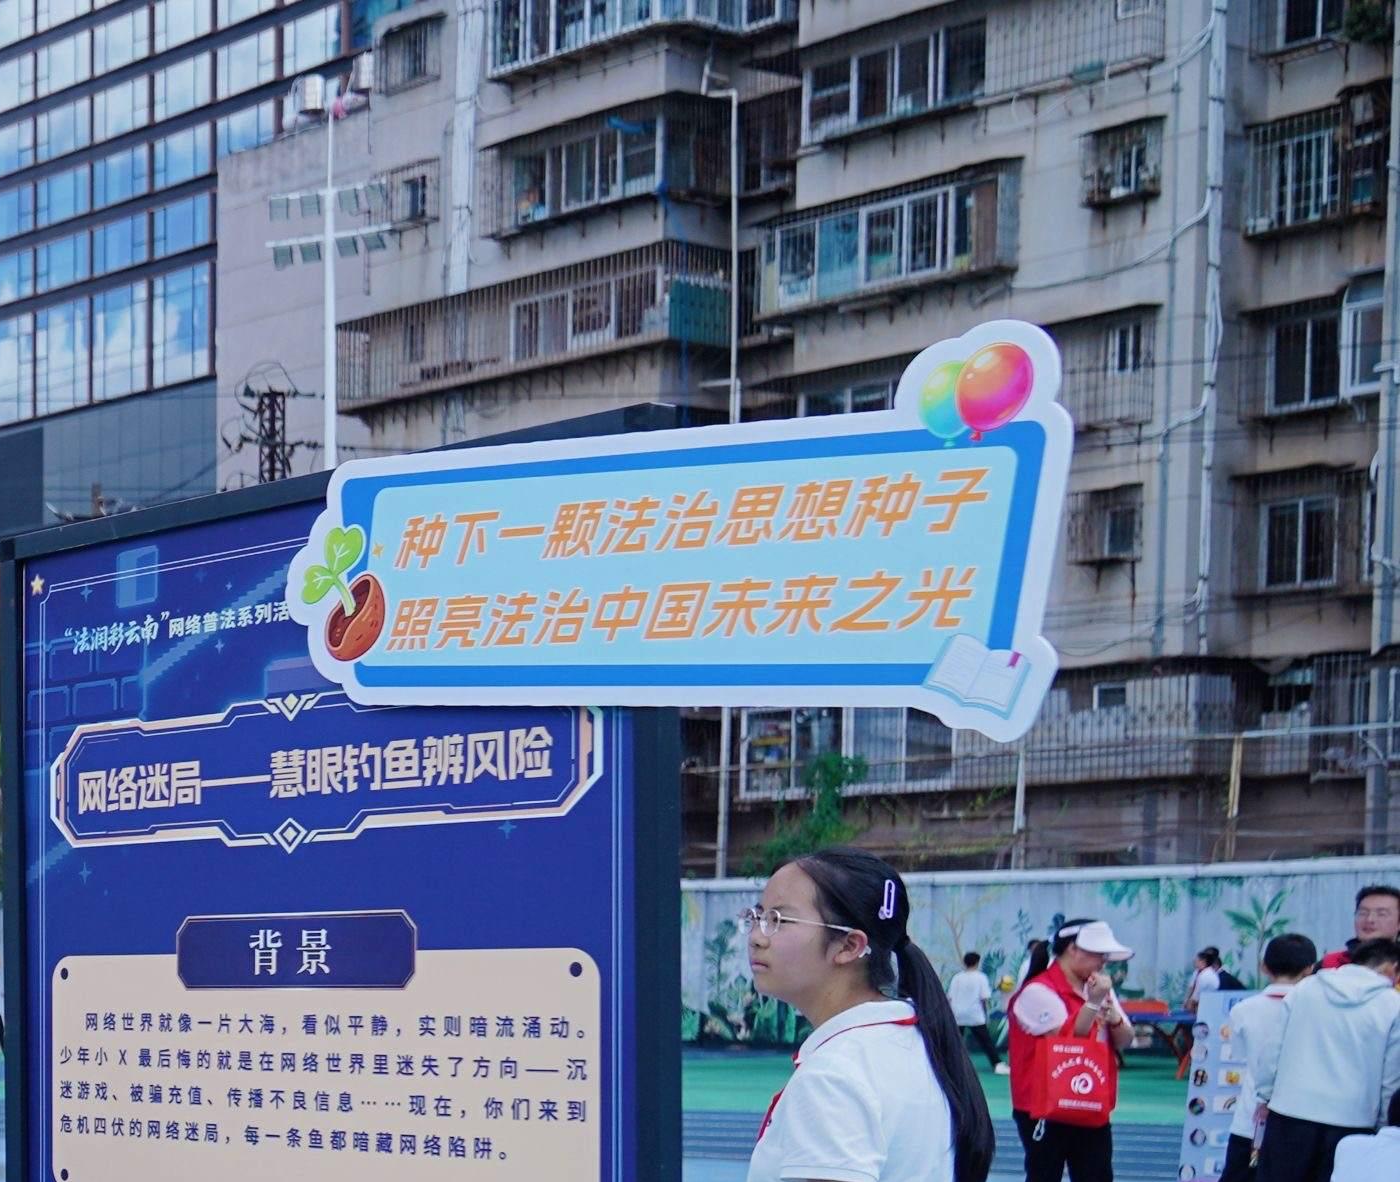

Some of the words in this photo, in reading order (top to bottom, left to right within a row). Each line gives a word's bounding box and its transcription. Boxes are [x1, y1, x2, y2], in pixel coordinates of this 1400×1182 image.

[393, 467, 990, 571] 种下一颗法治思想种子
[384, 566, 977, 652] 照亮法治中国未来之光
[77, 726, 553, 815] 网络迷局——慧眼钓鱼辨风险
[248, 928, 332, 976] 背景
[84, 1012, 586, 1040] 网络世界就像一片大海，看似平静，实则暗流涌动。
[59, 1114, 509, 1161] 危机四伏的网络迷局，每一条鱼都暗藏网络陷阱。
